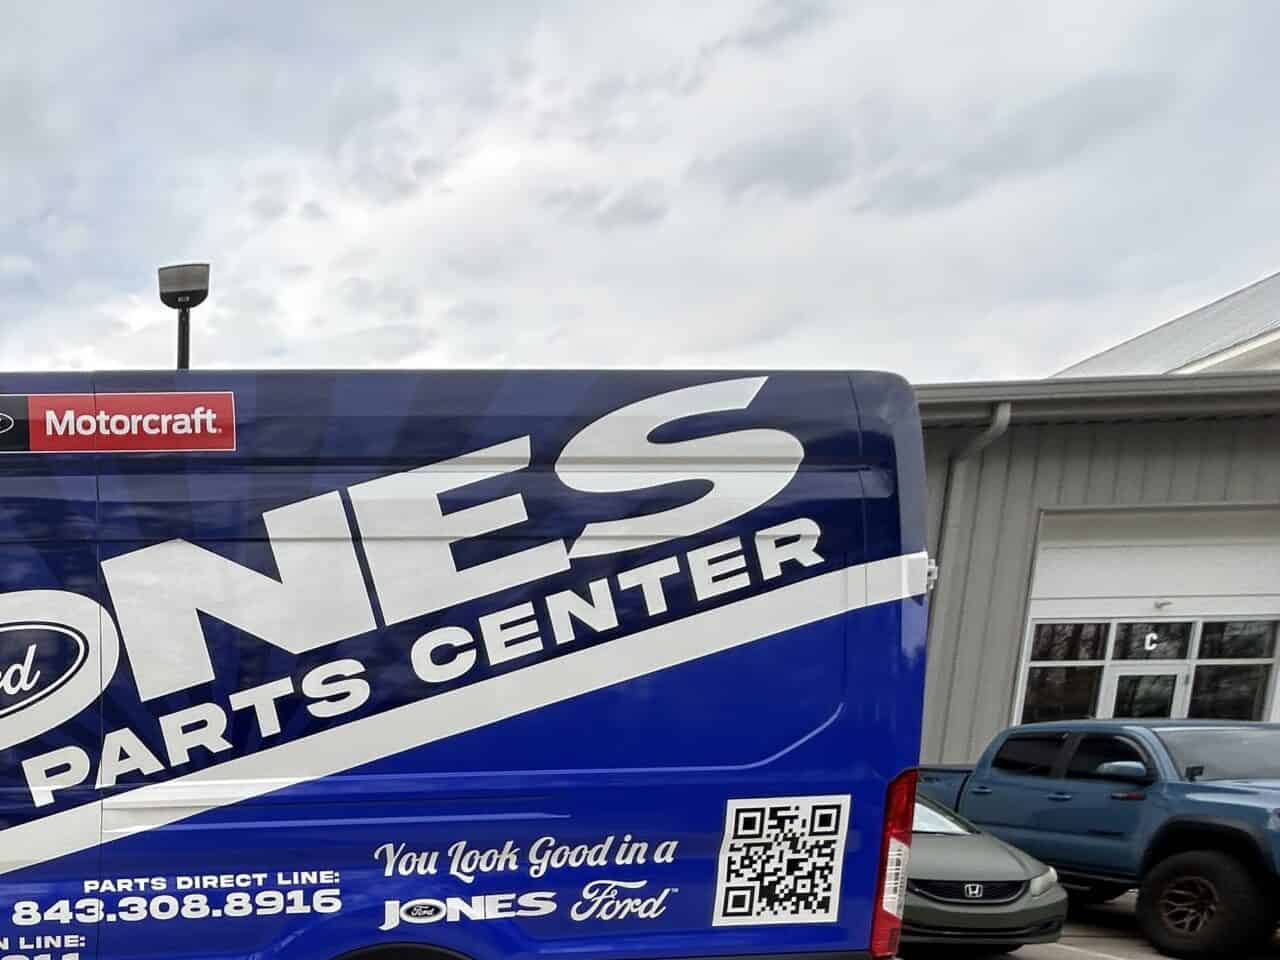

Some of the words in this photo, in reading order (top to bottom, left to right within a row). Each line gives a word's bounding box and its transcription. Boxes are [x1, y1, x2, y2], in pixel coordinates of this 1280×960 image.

[1145, 633, 1157, 650] C
[22, 659, 371, 808] PARTS
[410, 518, 826, 684] CENTER
[374, 842, 439, 876] You
[448, 840, 521, 884] Look
[528, 835, 616, 879] Good
[615, 833, 650, 865] in
[654, 840, 679, 864] a
[84, 877, 168, 894] PARTS
[177, 873, 268, 890] DIRECT
[277, 869, 341, 886] LINE:
[12, 888, 343, 926] 843.308.8916
[378, 890, 558, 931] JONES
[570, 878, 672, 922] Ford
[19, 934, 86, 950] LINE:
